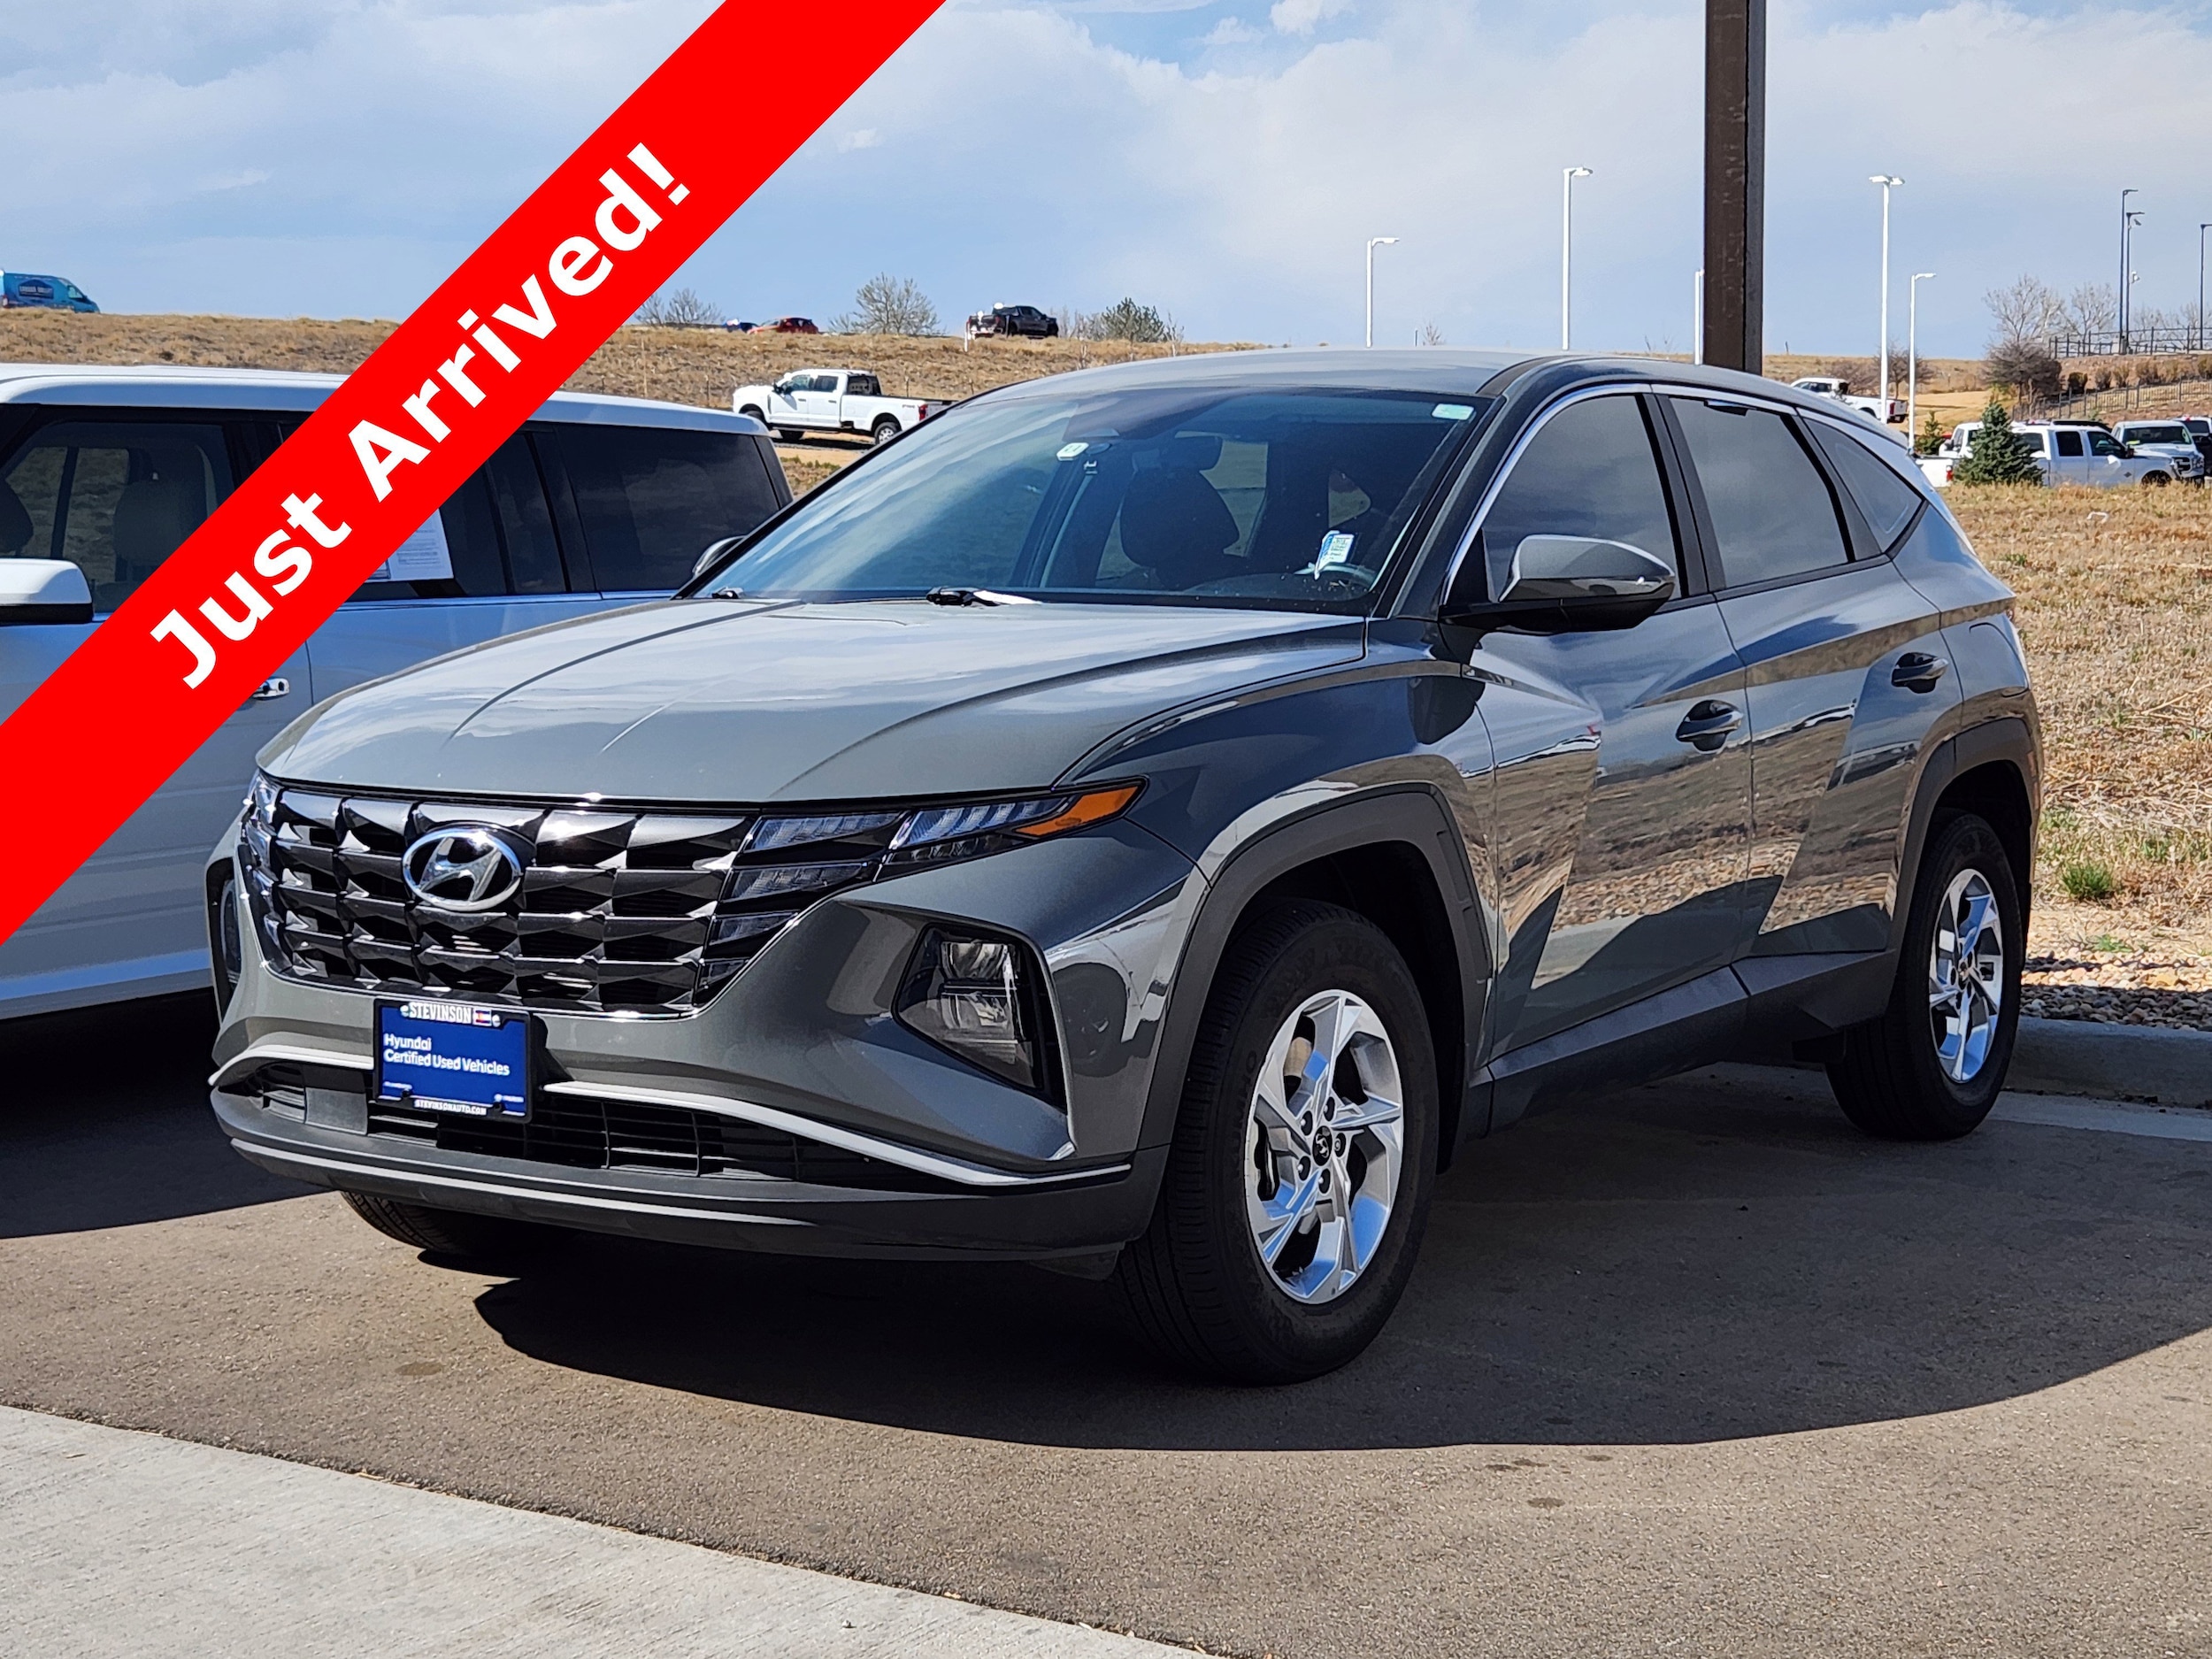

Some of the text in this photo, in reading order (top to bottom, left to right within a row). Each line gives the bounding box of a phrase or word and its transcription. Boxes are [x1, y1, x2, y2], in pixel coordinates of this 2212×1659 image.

[409, 1002, 472, 1024] STEVINSON
[383, 1033, 432, 1051] Hyundai
[383, 1048, 511, 1076] Certified Used Vehicles
[414, 1099, 487, 1116] STEVINSONAUTO.COM
